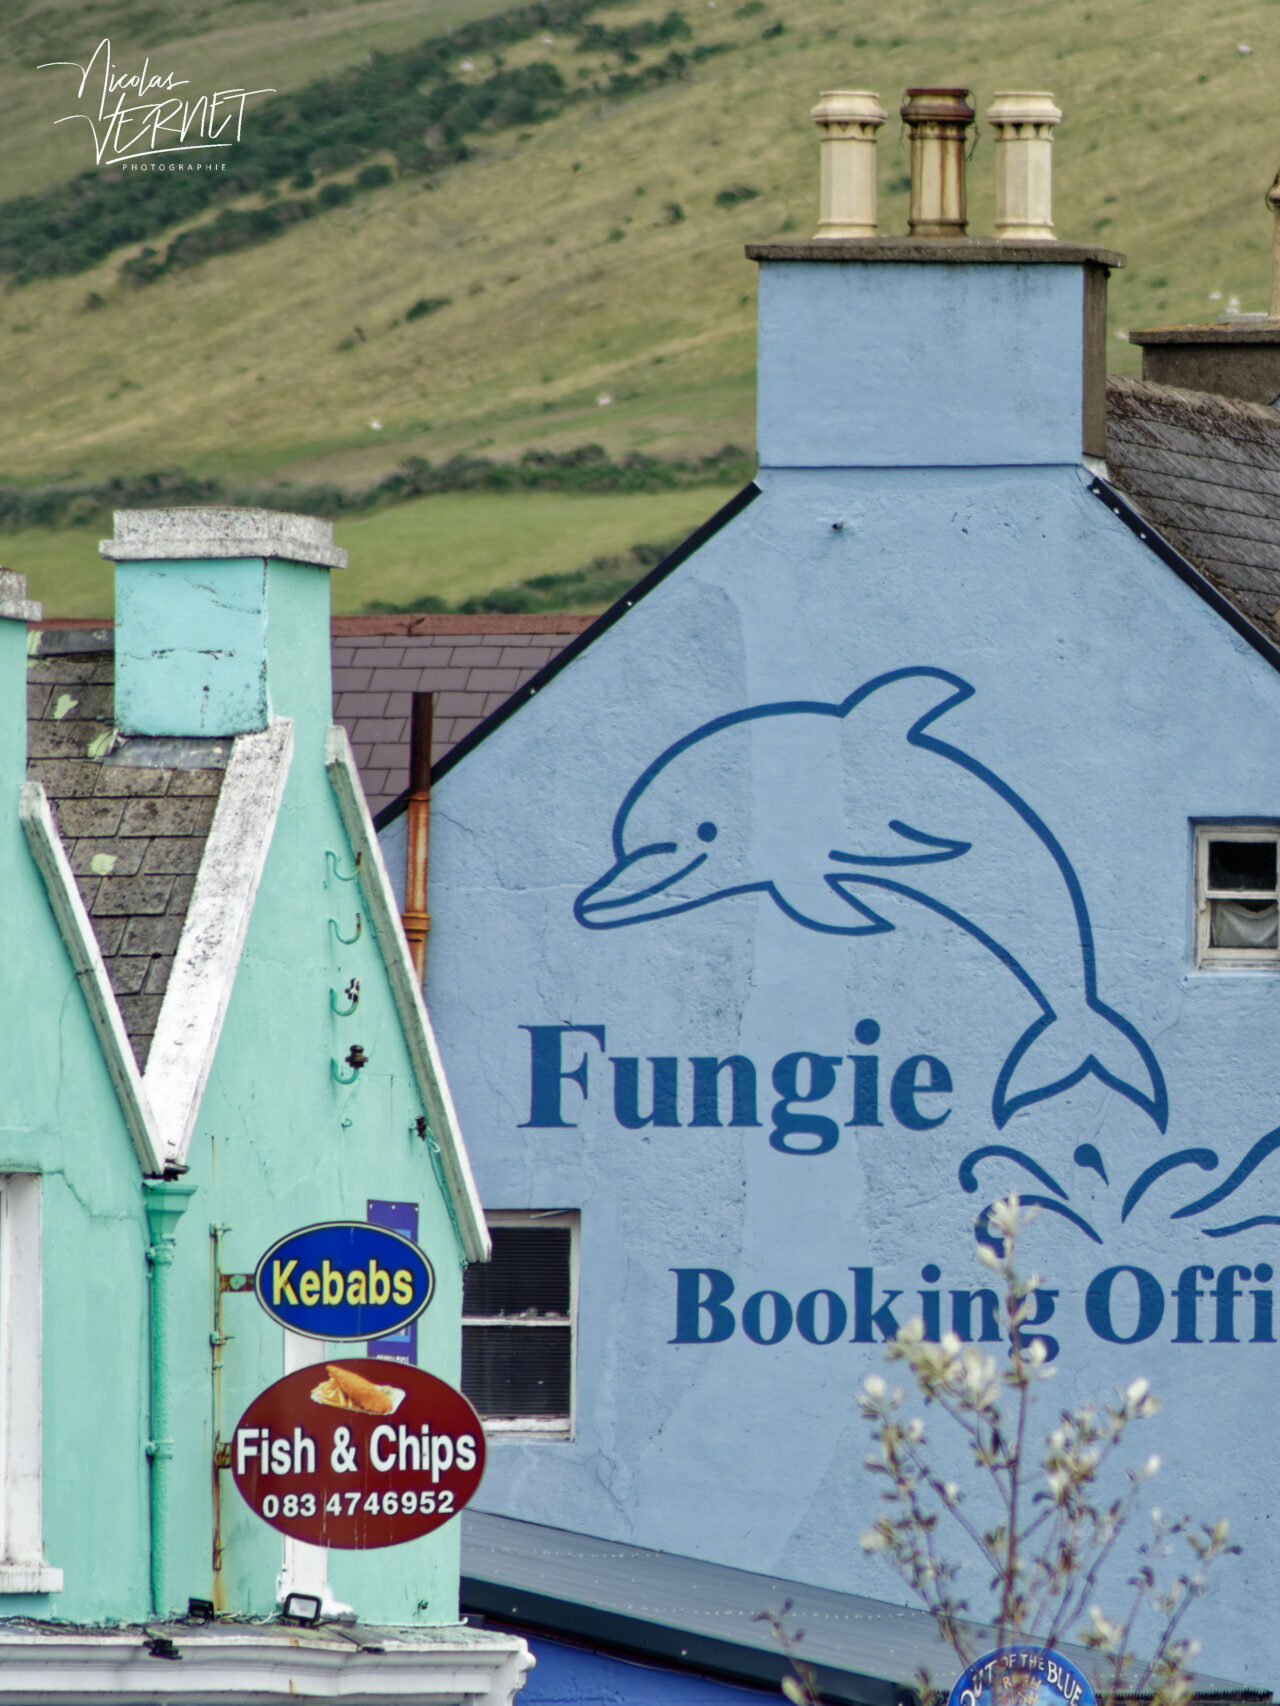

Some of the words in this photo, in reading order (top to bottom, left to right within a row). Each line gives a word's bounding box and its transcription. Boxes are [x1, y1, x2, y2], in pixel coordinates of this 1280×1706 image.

[517, 1018, 953, 1155] Fungie
[272, 1259, 414, 1306] Kebabs
[667, 1264, 1059, 1363] Booking
[237, 1426, 316, 1475] Fish
[330, 1426, 358, 1473] &
[370, 1424, 477, 1483] Chips
[262, 1493, 316, 1518] 083
[326, 1490, 454, 1516] 4746952
[1020, 1654, 1044, 1670] THE
[1046, 1660, 1083, 1706] BLUE
